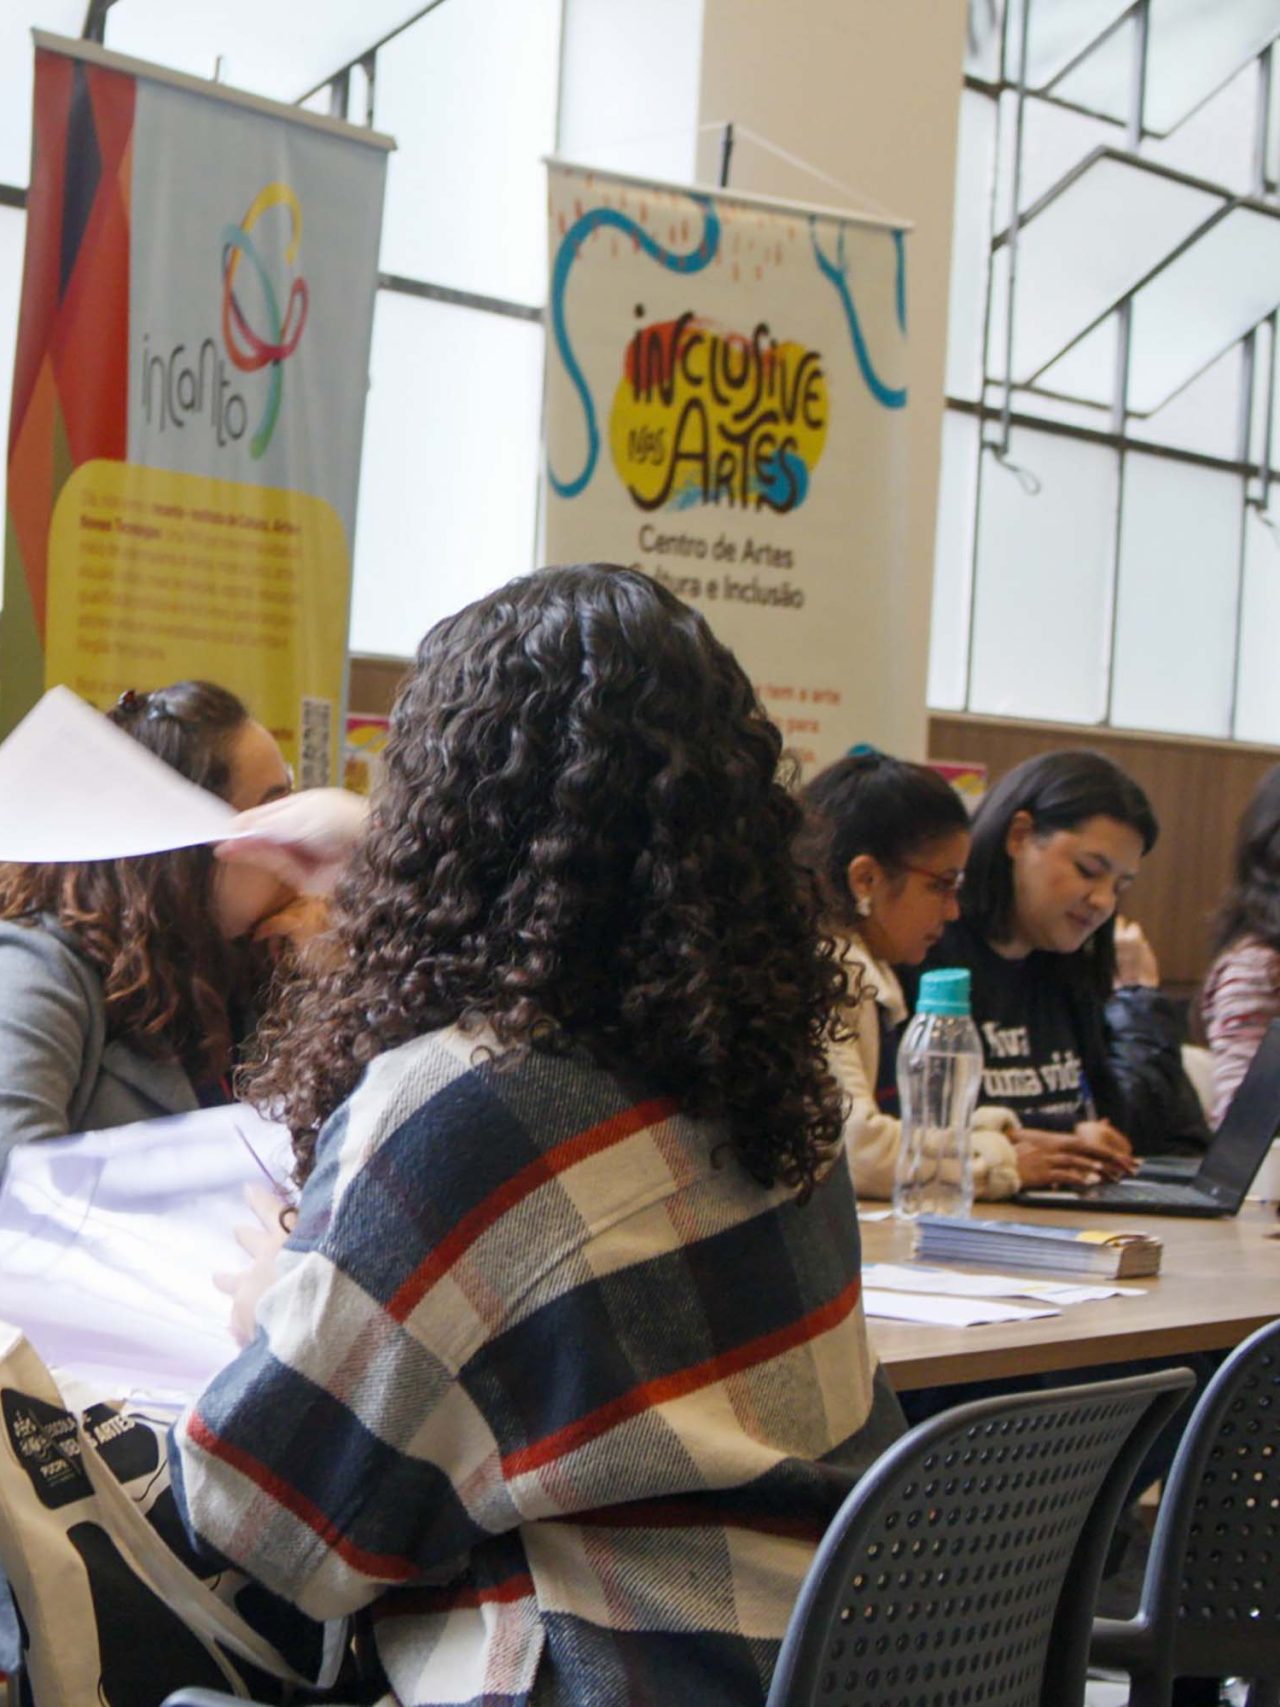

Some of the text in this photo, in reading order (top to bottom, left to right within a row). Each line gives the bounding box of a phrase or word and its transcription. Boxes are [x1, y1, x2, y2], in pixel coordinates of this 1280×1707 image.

[141, 333, 248, 449] incanto
[639, 523, 795, 569] Centro de Artes
[706, 580, 719, 599] e
[723, 573, 806, 610] Inclusão
